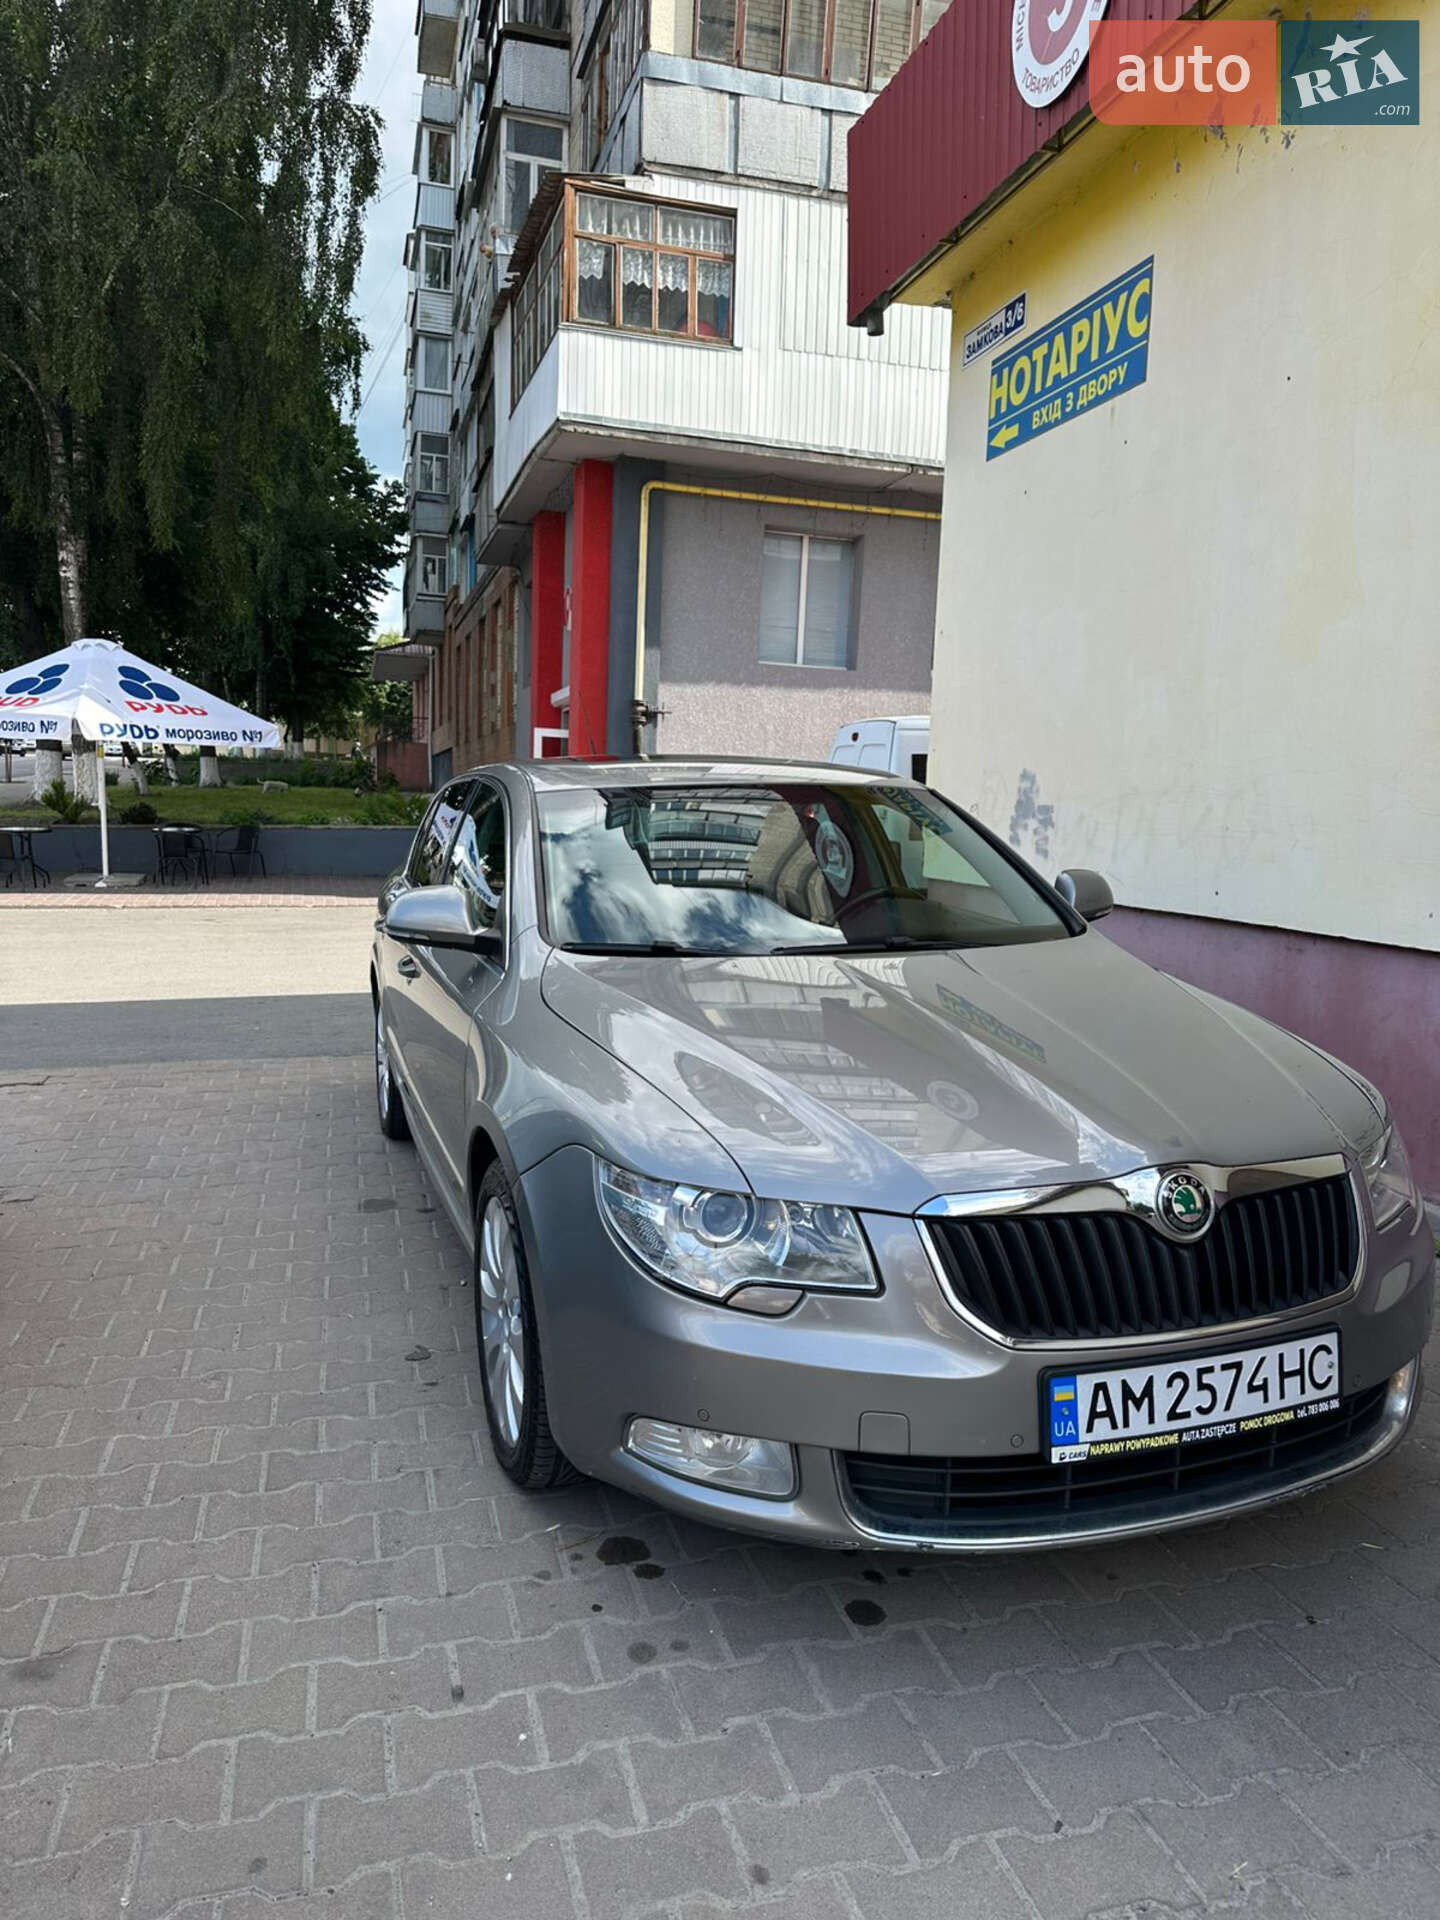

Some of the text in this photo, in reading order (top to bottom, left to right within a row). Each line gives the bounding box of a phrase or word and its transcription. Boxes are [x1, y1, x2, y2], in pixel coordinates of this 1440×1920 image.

[1022, 48, 1080, 94] ТОВАРИСТВО
[966, 321, 1003, 359] ЗАМКОВА
[1006, 302, 1024, 329] 3/6
[990, 277, 1151, 419] НОТАРІУС
[1032, 398, 1062, 430] ВХІД
[1077, 361, 1128, 410] ДВОРУ
[166, 728, 238, 742] морозиво
[1054, 1421, 1076, 1437] UA
[1090, 1440, 1125, 1456] NAPRAWY
[1181, 1430, 1200, 1442] AUTA
[1240, 1416, 1263, 1431] POMOC
